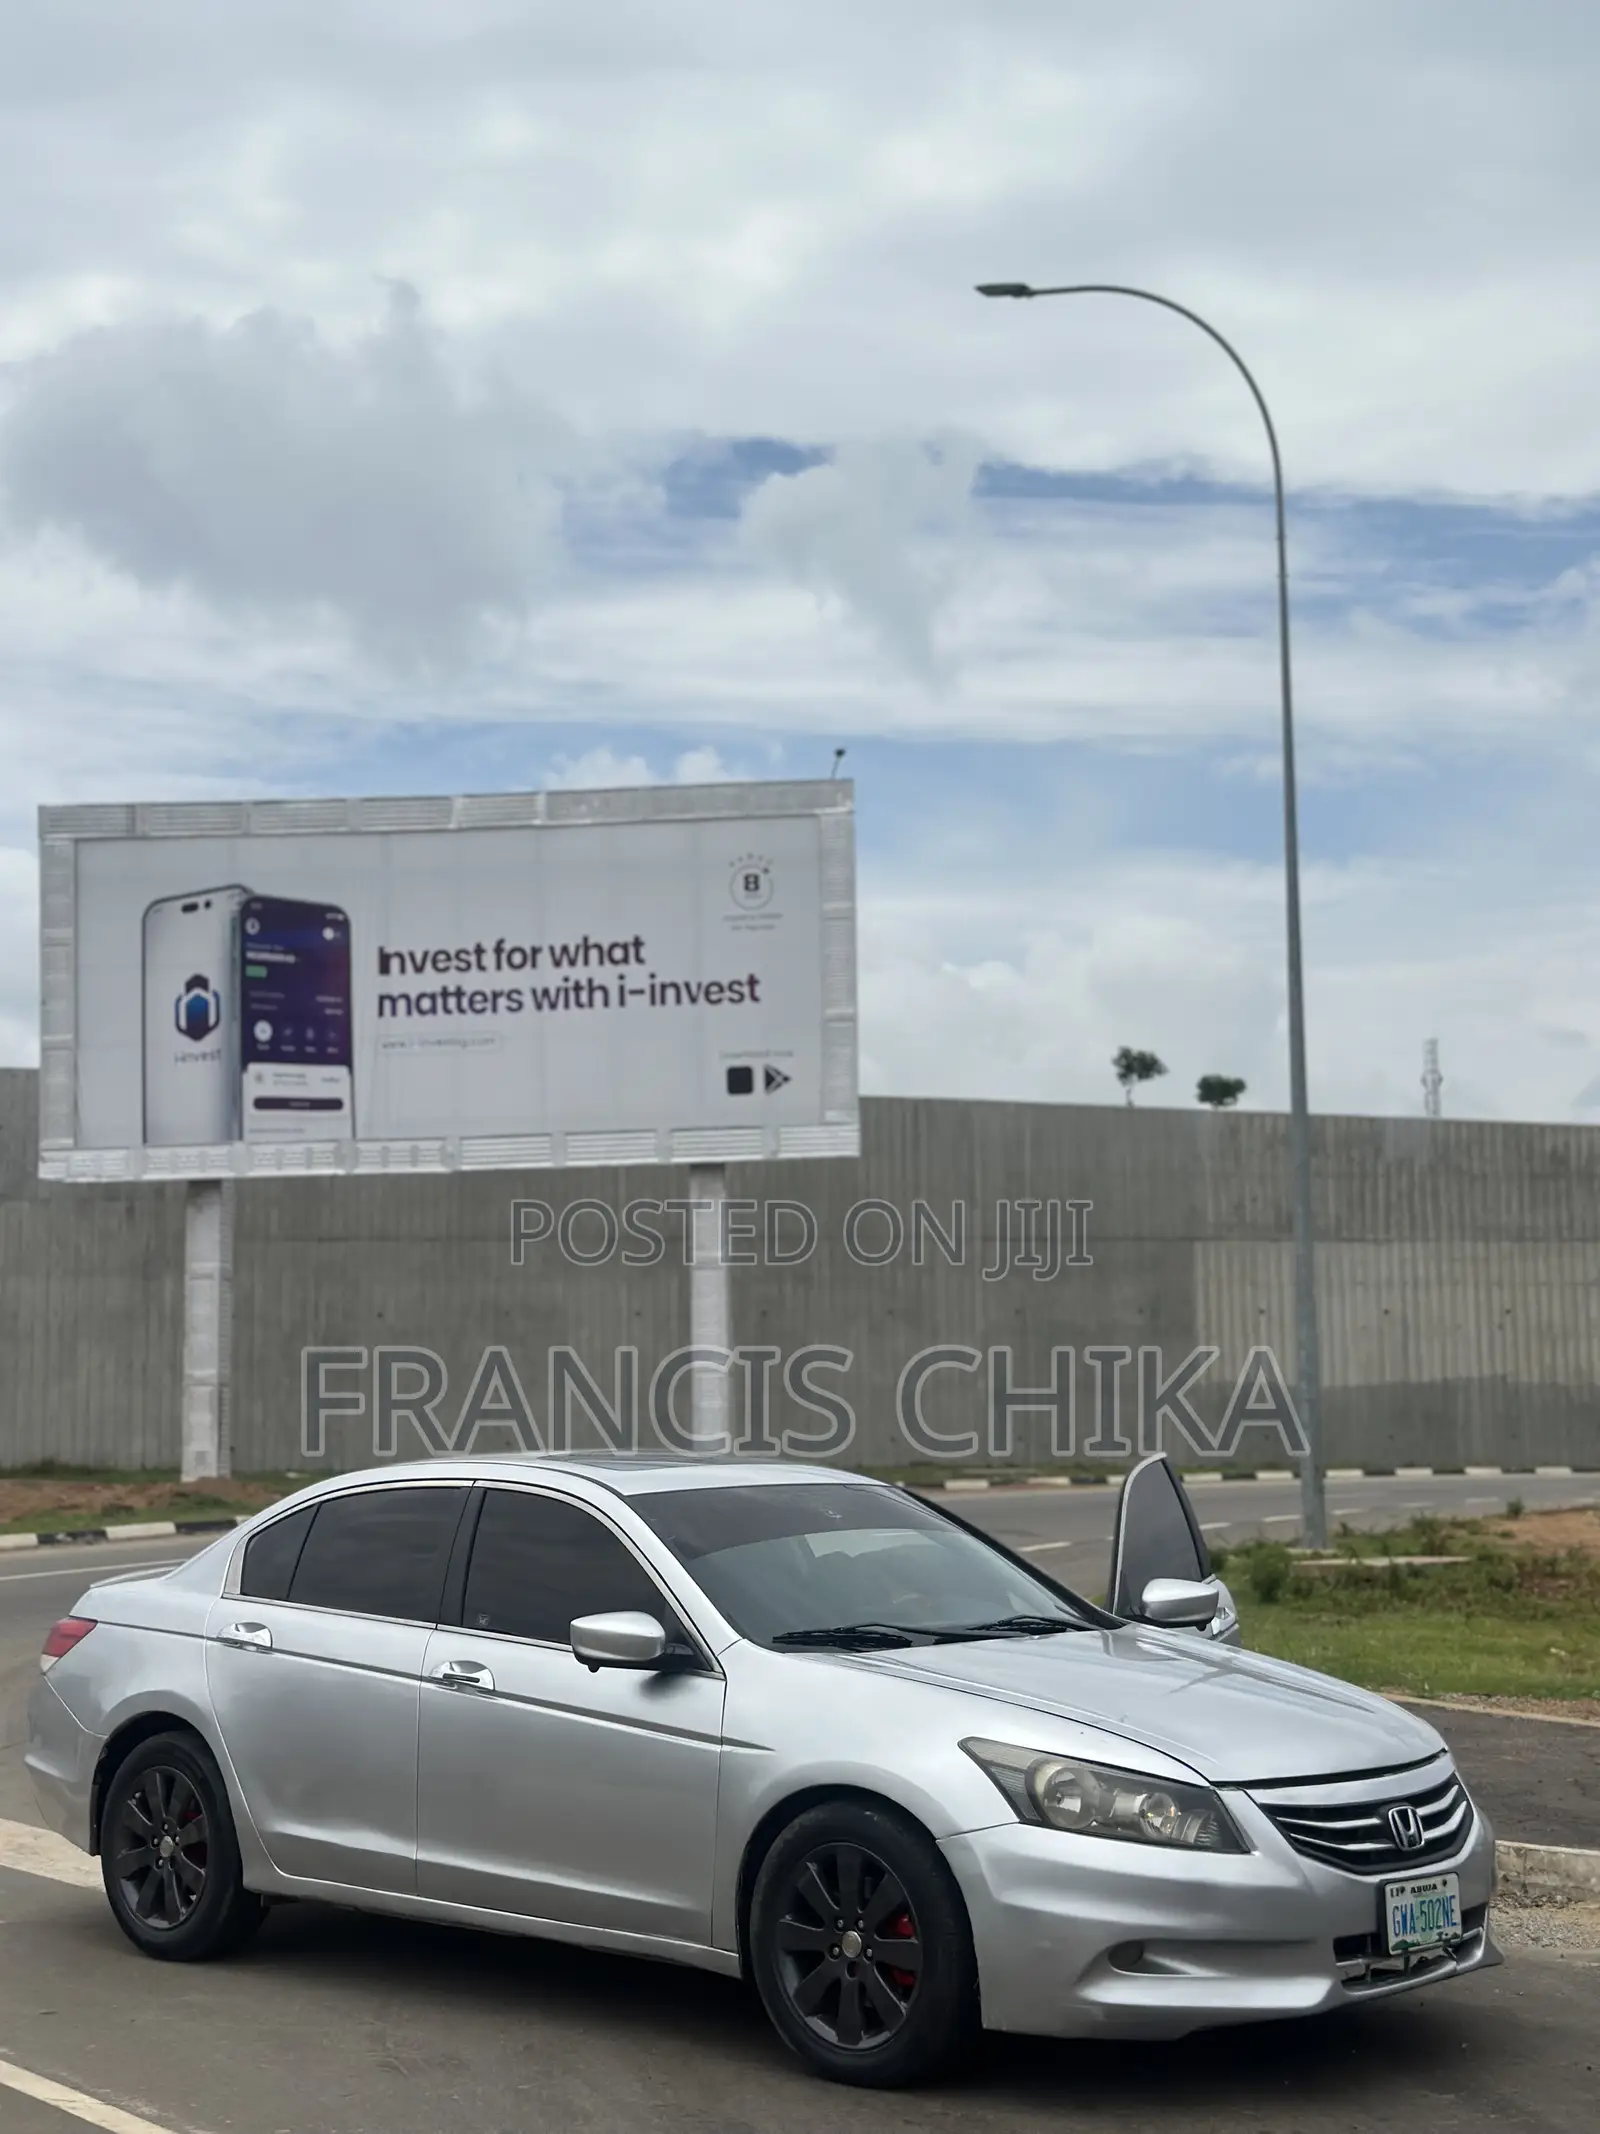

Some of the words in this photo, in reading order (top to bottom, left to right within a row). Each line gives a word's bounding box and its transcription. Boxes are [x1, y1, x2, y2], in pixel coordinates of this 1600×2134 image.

[377, 941, 487, 976] Invest
[495, 938, 543, 972] for
[549, 935, 645, 969] what
[377, 985, 524, 1018] matters
[530, 976, 610, 1011] with
[617, 972, 761, 1009] i-invest
